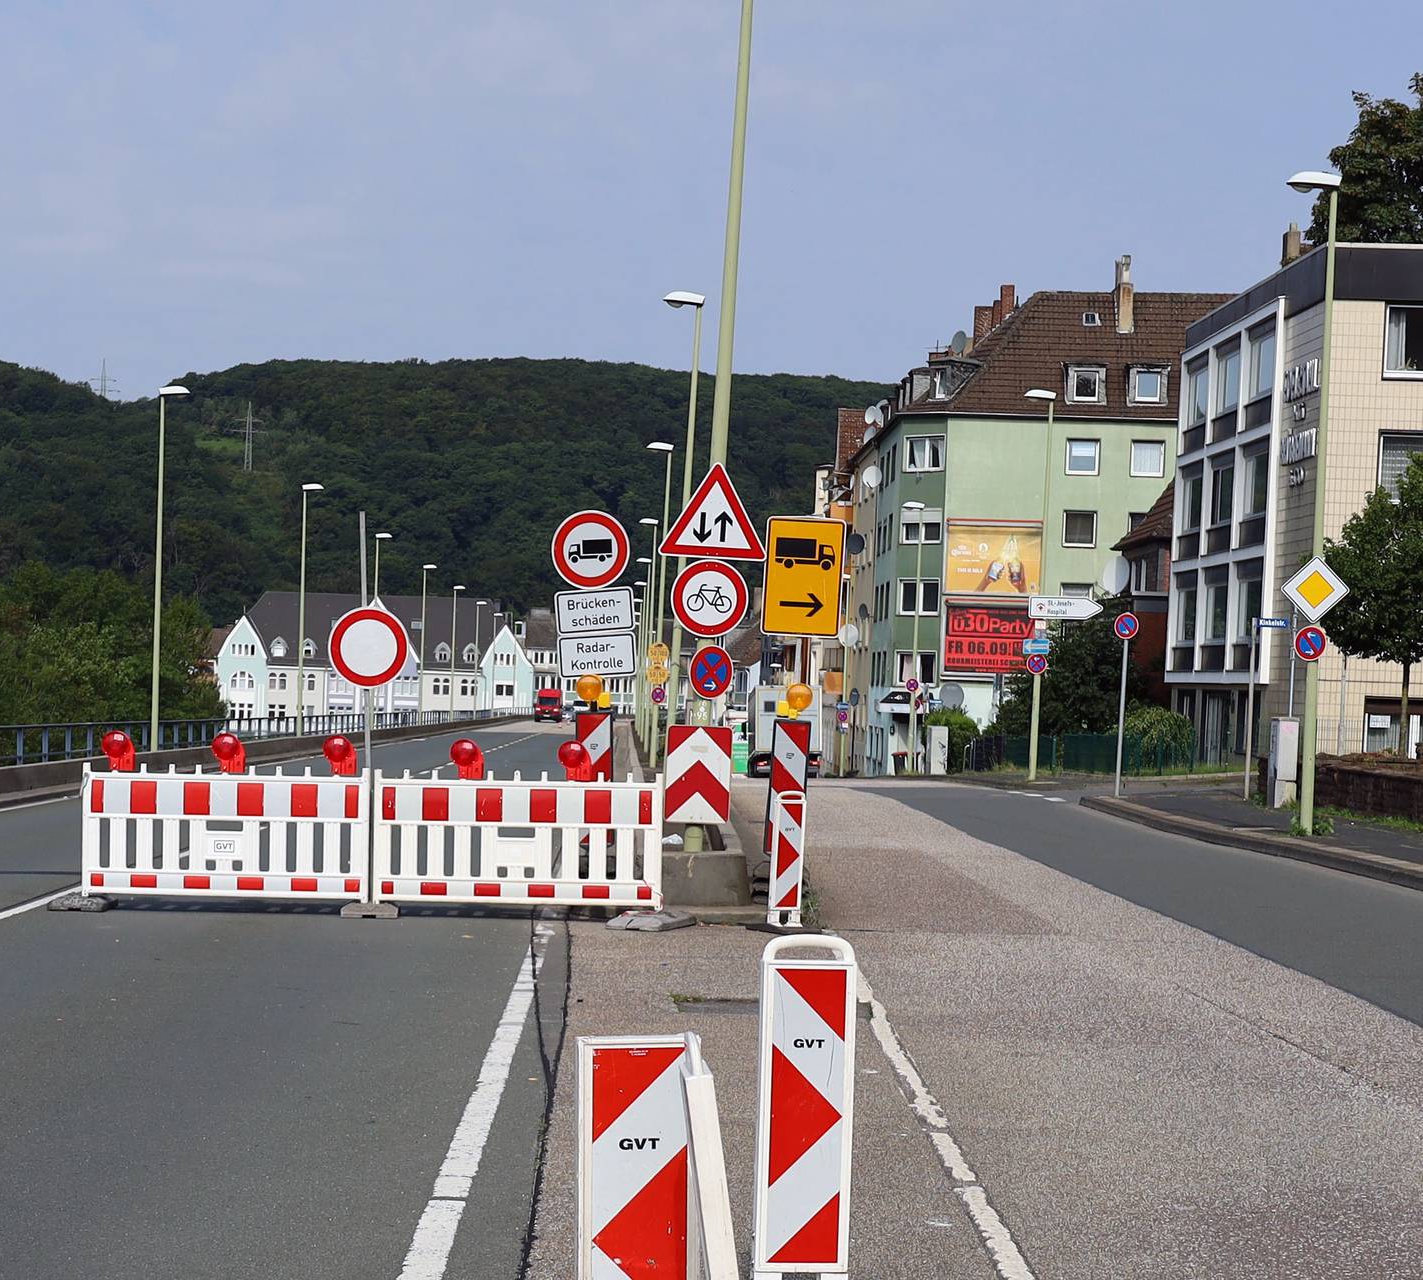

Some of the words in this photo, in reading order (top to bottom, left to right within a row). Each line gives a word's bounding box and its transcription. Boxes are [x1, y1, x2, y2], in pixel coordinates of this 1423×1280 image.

[567, 598, 621, 611] Brücken-
[571, 614, 620, 627] schäden
[1259, 619, 1286, 627] Kinkelstr.
[576, 642, 616, 654] Radar-
[948, 640, 963, 654] FR
[571, 657, 624, 671] Kontrolle
[216, 842, 233, 850] GVT
[793, 1038, 825, 1049] GVT
[619, 1138, 660, 1150] GVT
